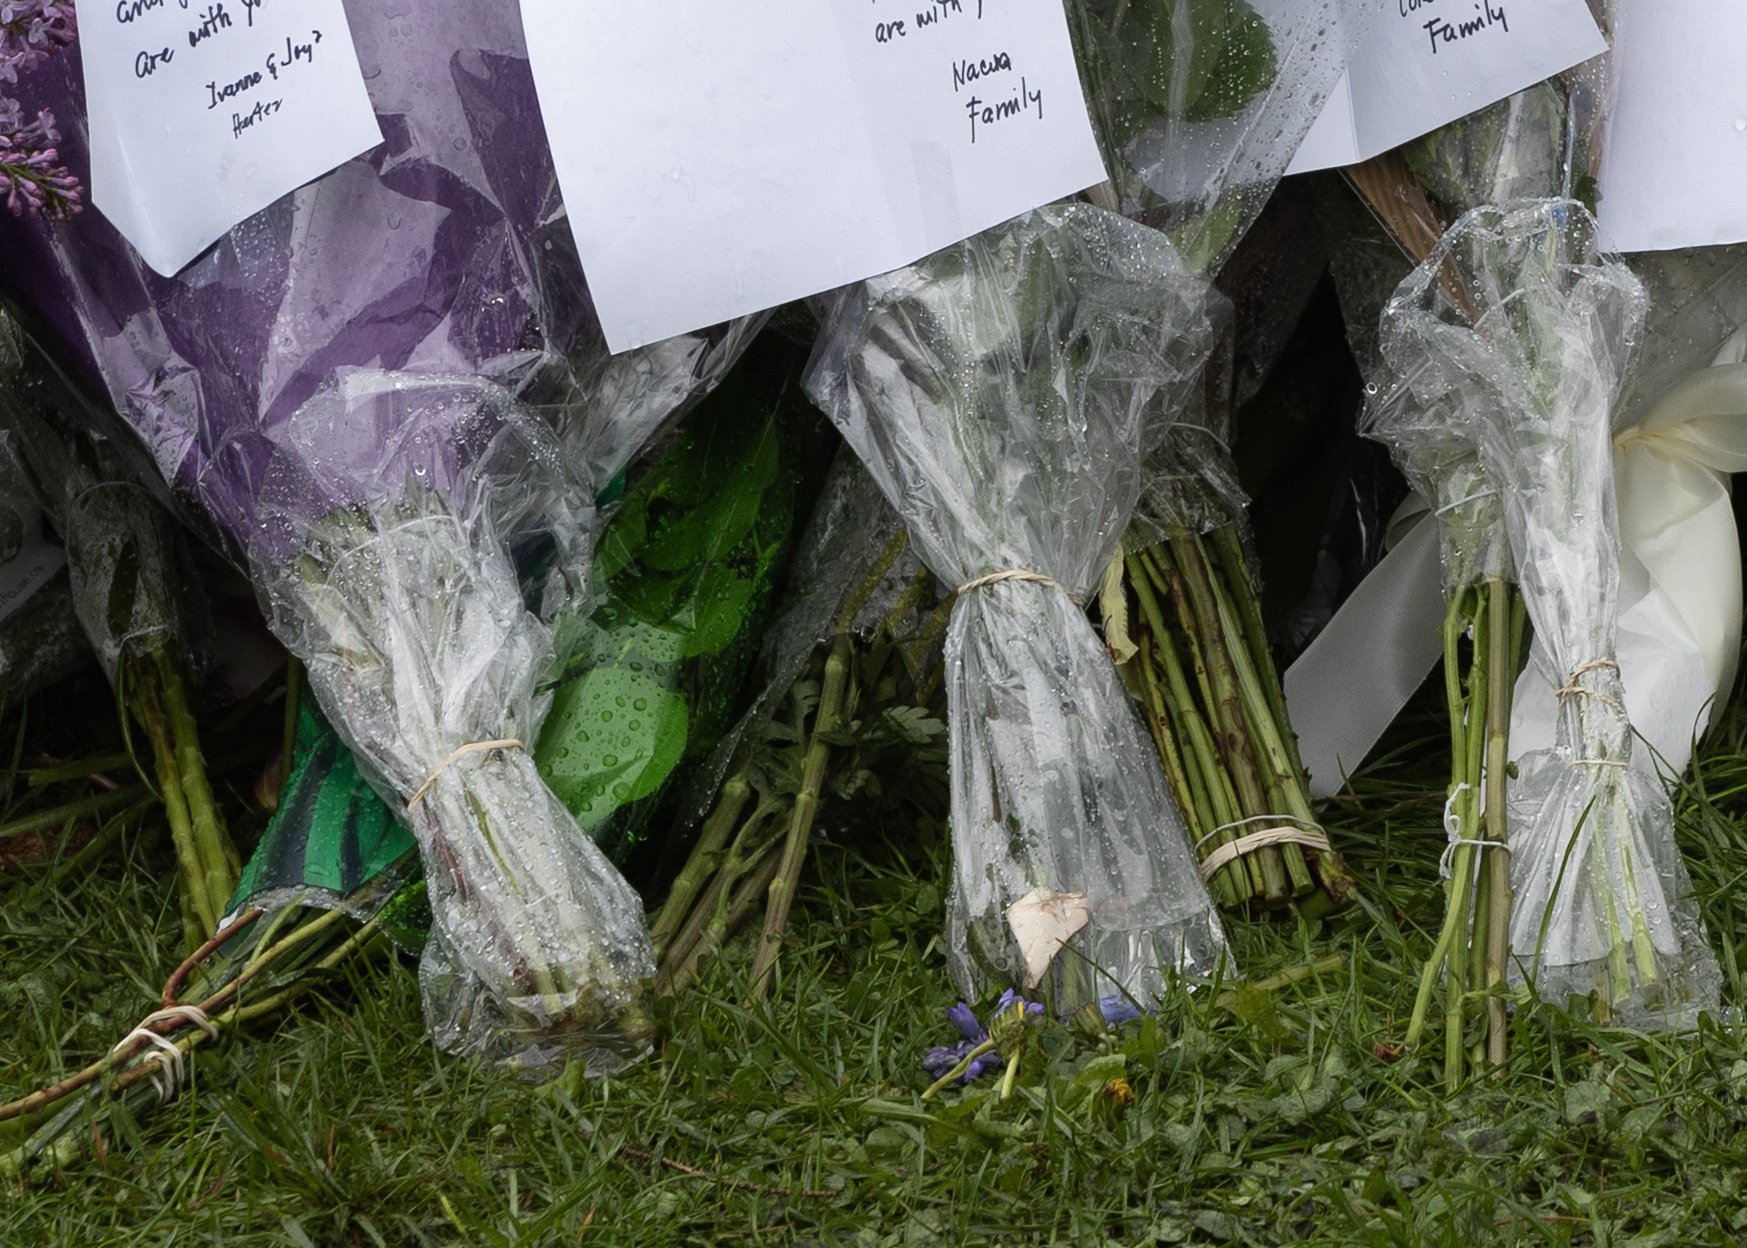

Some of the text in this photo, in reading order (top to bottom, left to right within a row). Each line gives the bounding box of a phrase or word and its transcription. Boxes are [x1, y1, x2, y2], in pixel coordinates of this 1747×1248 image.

[135, 46, 175, 79] are
[188, 3, 233, 48] with
[874, 17, 907, 44] are
[966, 76, 1043, 144] Family
